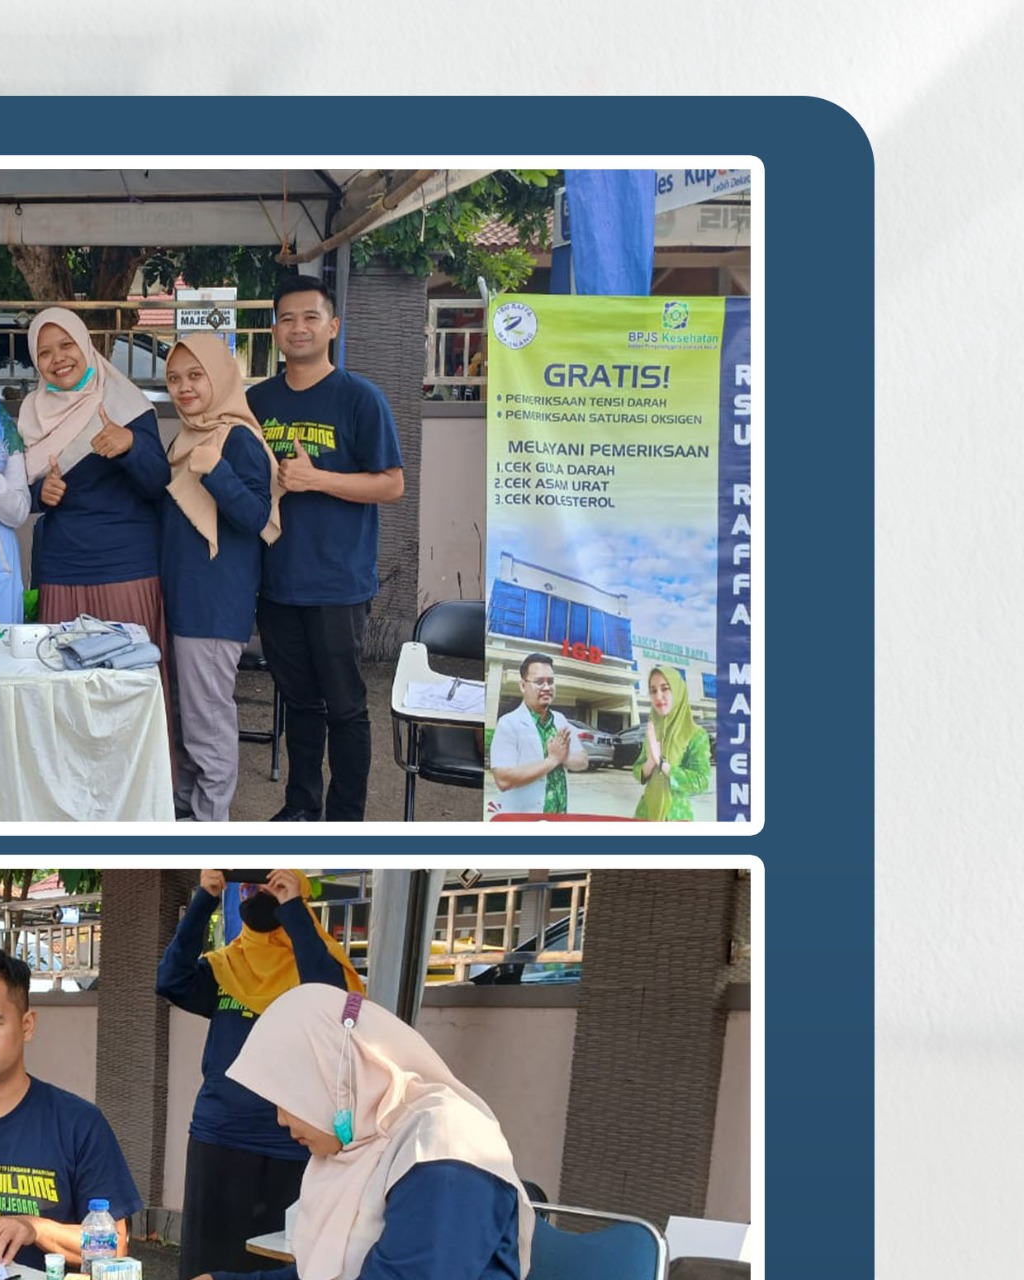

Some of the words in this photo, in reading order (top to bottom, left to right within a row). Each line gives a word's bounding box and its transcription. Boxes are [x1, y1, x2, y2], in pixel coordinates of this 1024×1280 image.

[628, 332, 658, 343] BPJS
[662, 332, 719, 344] Kesehatan
[543, 363, 670, 389] GRATIS!
[590, 398, 624, 407] TENSI
[627, 398, 667, 408] DARAH
[589, 413, 648, 424] SATURASI
[651, 414, 702, 425] OKSIGEN
[508, 440, 585, 456] MELAYANI
[589, 444, 709, 458] PEMERIKSAAN
[567, 465, 615, 476] DARAH
[535, 478, 569, 491] ASAM
[572, 481, 610, 492] URAT
[535, 494, 616, 508] KOLESTEROL
